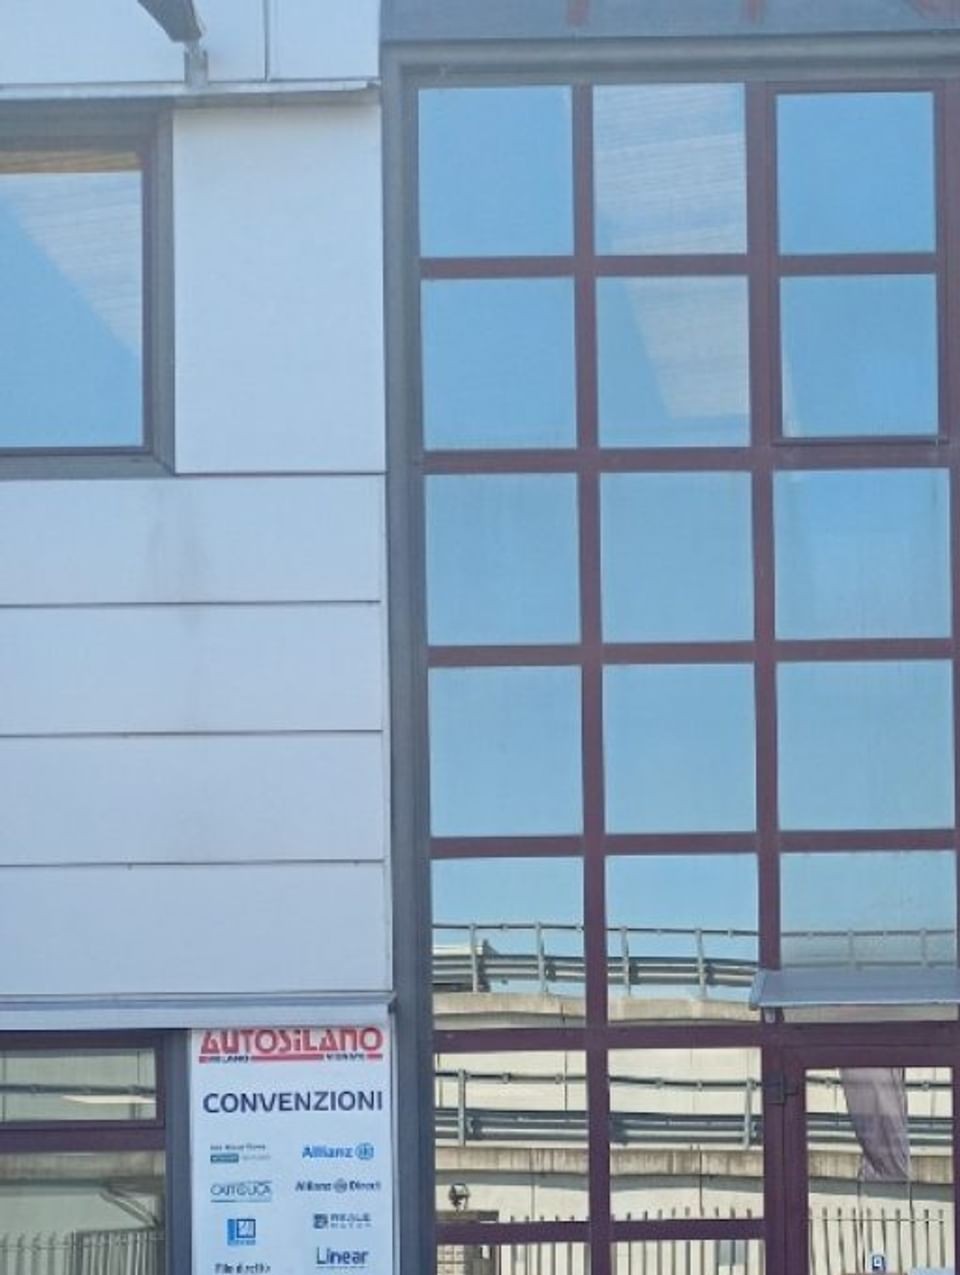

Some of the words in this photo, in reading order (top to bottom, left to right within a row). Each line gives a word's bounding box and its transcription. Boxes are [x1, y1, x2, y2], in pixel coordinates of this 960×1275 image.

[202, 1090, 383, 1113] CONVENZIONI
[302, 1144, 353, 1159] Allianz
[316, 1247, 369, 1265] Linear
